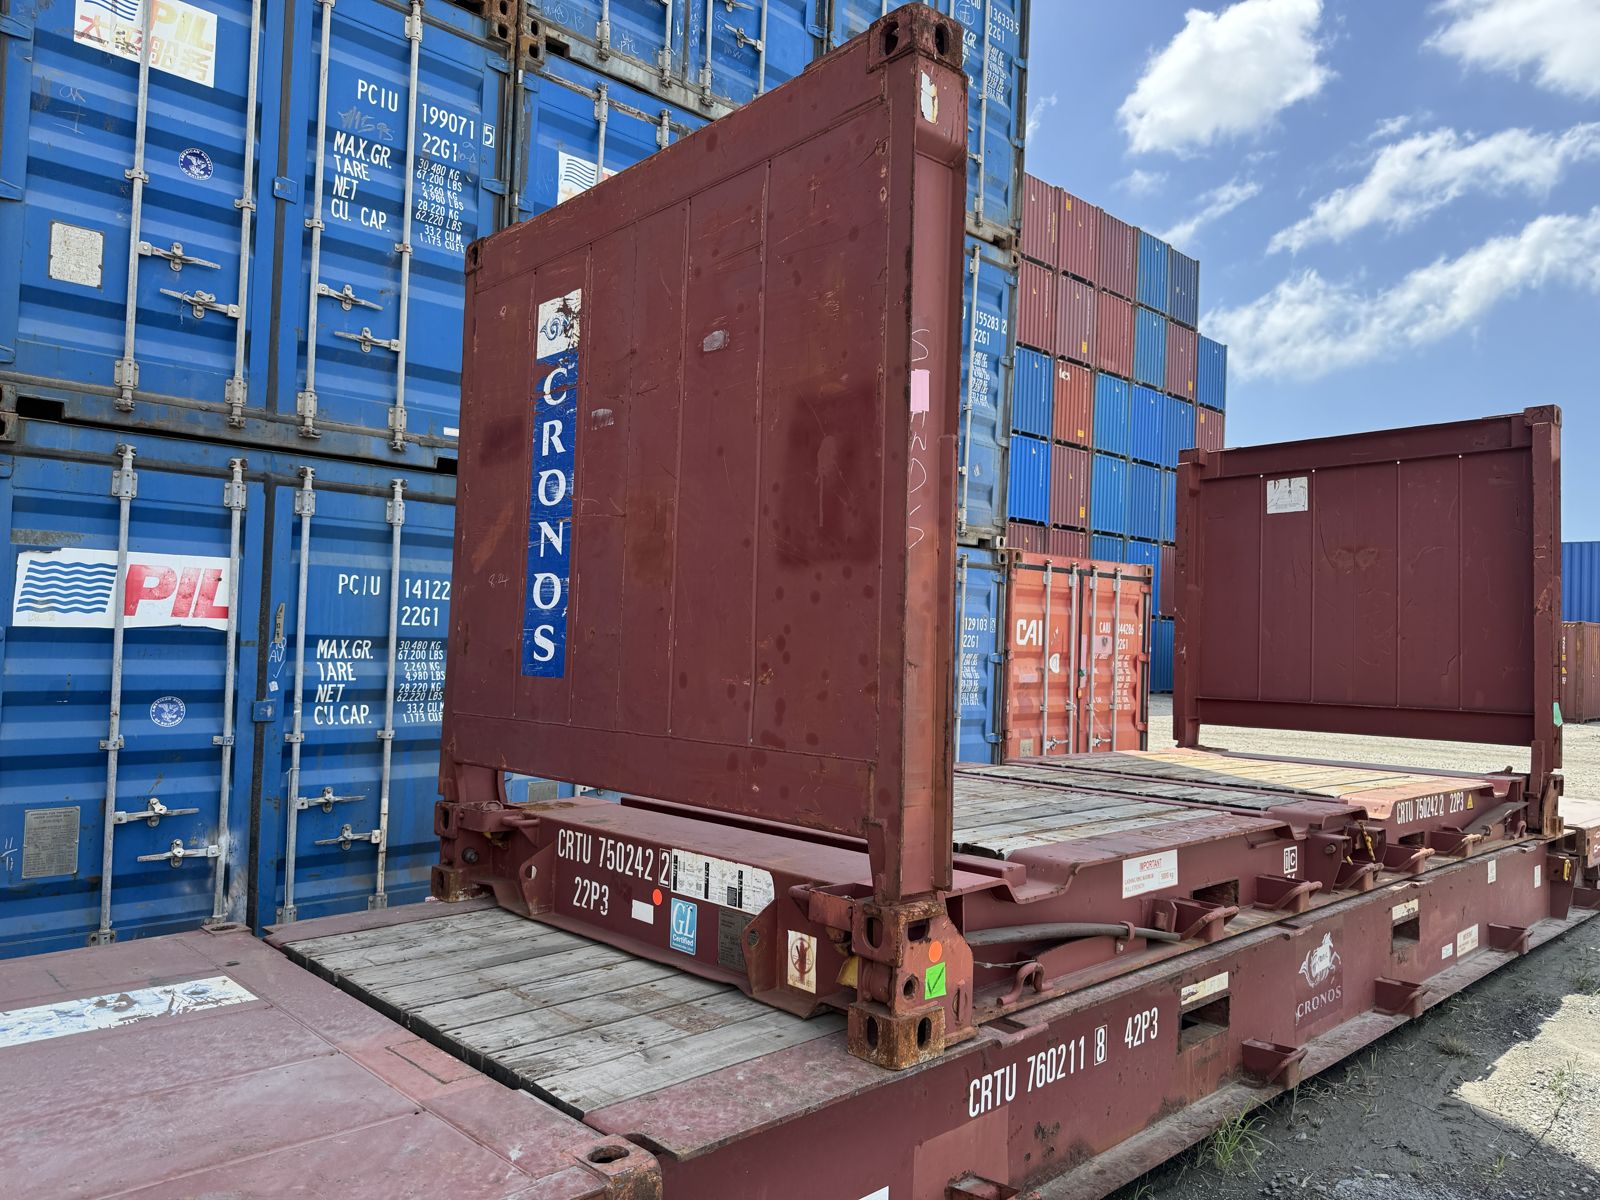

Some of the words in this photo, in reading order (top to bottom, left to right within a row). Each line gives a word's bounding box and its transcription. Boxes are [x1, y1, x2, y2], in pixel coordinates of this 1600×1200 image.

[990, 5, 1014, 32] 136333
[988, 22, 1005, 44] 22G1
[357, 79, 399, 112] PCIU
[422, 103, 475, 140] 199071
[484, 125, 494, 147] 5
[334, 130, 392, 170] MAX.GR.
[422, 132, 458, 162] 22G1
[334, 155, 370, 182] TARE
[418, 159, 446, 178] 30.480
[448, 168, 460, 180] KG
[333, 174, 358, 200] NET
[447, 178, 462, 192] LBS
[447, 189, 458, 200] KG
[418, 200, 446, 217] 28.220
[448, 208, 459, 220] KG
[448, 198, 464, 211] LBS
[331, 199, 352, 222] CU.
[360, 206, 390, 233] CAP.
[416, 211, 444, 228] 62.220
[446, 218, 462, 232] LBS
[976, 310, 999, 331] 155283
[974, 328, 990, 346] 22G1
[532, 367, 569, 663] CRONOS
[124, 564, 229, 619] PIL
[338, 574, 381, 596] PCIU
[401, 606, 438, 626] 22G1
[965, 617, 988, 631] 129103
[963, 634, 979, 648] 22G1
[1016, 619, 1043, 646] CAI
[316, 638, 374, 660] MAX.GR.
[398, 650, 426, 660] 67.200
[429, 650, 444, 660] LBS
[399, 640, 428, 650] 30.480
[430, 641, 442, 650] KG
[316, 662, 356, 681] TARE
[404, 662, 427, 671] 2.260
[430, 662, 440, 671] KG
[405, 671, 428, 681] 4.980
[431, 671, 445, 680] LBS
[314, 684, 345, 702] NET
[397, 692, 426, 701] 62.220
[428, 692, 443, 701] LBS
[400, 683, 428, 692] 28.220
[431, 683, 442, 692] KG
[407, 704, 424, 713] 33.2
[1396, 802, 1413, 824] CRTU
[1416, 795, 1438, 820] 750242
[1450, 792, 1464, 813] 22P3
[558, 828, 592, 864] CRTU
[598, 837, 654, 881] 750242
[660, 850, 670, 886] 2
[572, 876, 609, 916] 22P3
[673, 902, 694, 938] GL
[672, 934, 694, 946] Certified
[1297, 985, 1342, 1020] CRONOS
[969, 1062, 1016, 1118] CRTU
[1026, 1035, 1085, 1092] 760211
[1096, 1027, 1106, 1063] 8
[1124, 1006, 1158, 1049] 42P3
